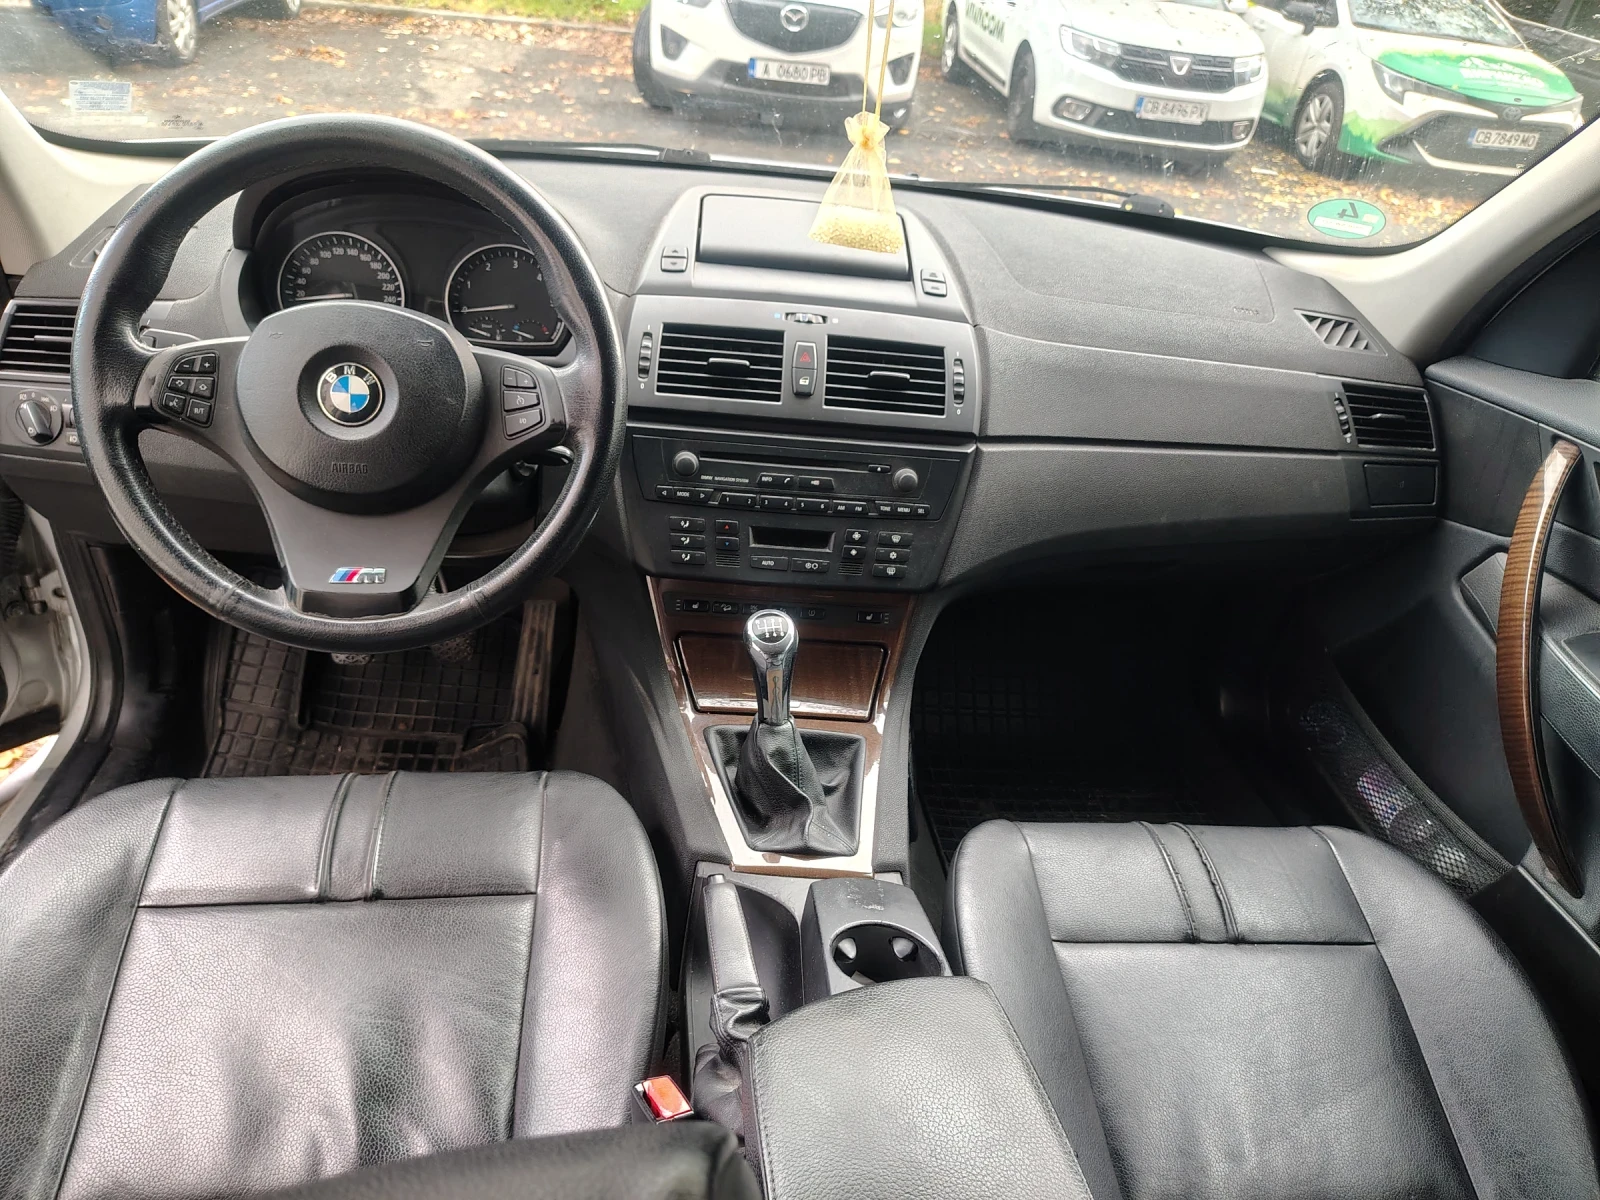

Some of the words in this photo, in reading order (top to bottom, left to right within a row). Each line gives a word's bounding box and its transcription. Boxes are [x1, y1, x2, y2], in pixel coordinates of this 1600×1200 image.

[1475, 130, 1492, 144] CB
[1491, 132, 1520, 147] 7849
[325, 365, 376, 386] BMW
